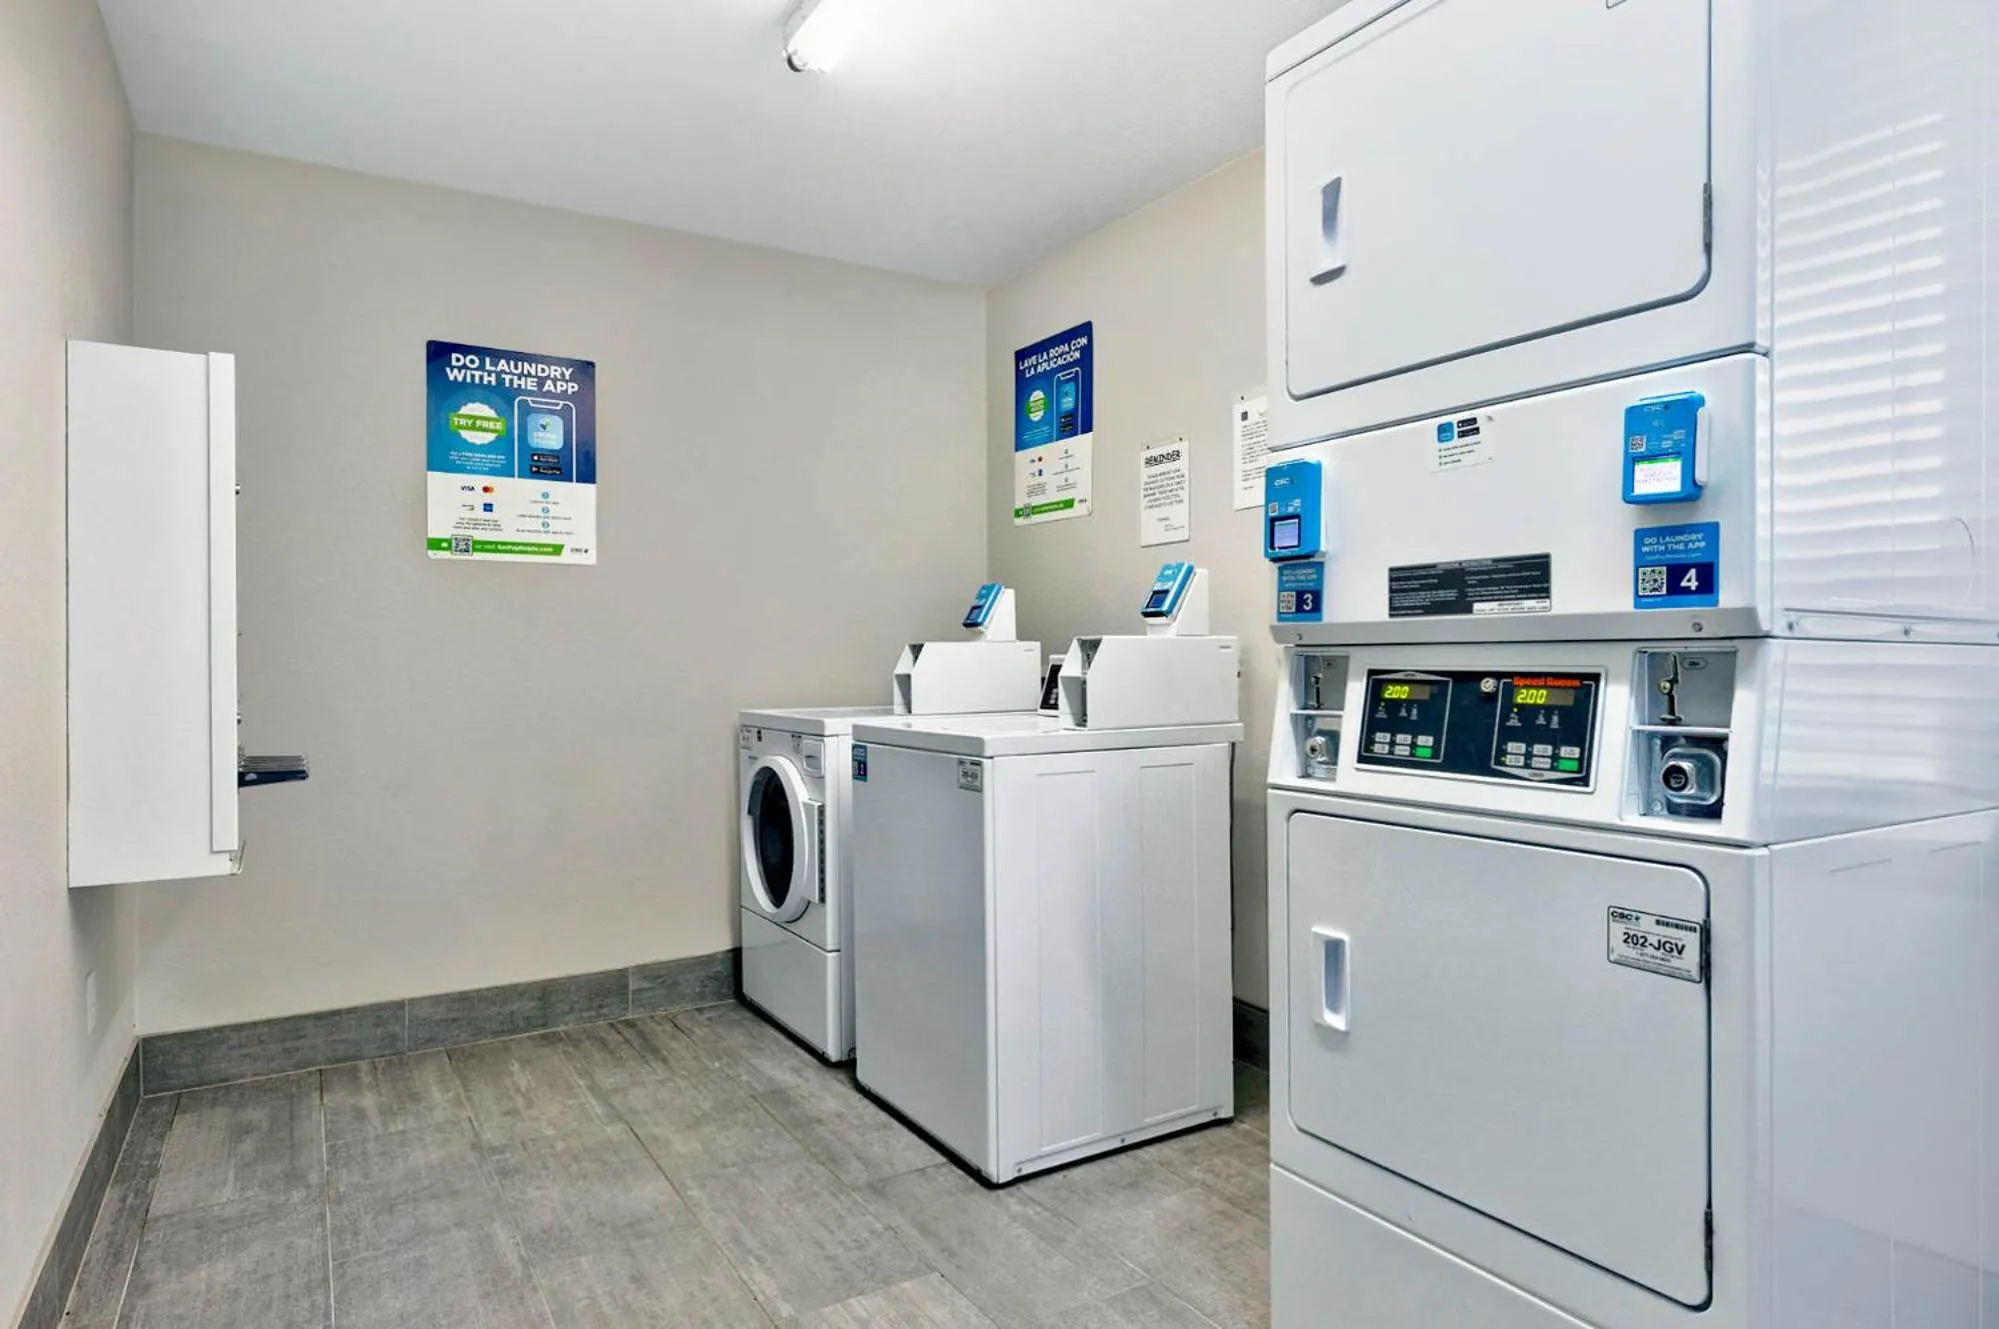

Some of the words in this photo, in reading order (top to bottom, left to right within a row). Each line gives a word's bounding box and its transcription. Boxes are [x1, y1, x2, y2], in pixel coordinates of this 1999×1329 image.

[1019, 354, 1037, 370] LAVE
[1038, 352, 1048, 363] LA
[1049, 343, 1070, 358] ROPA
[1071, 336, 1088, 349] CON
[451, 352, 480, 368] DO
[485, 356, 574, 380] LAUNDRY
[1025, 368, 1035, 378] LA
[1036, 350, 1081, 373] APLICACIÓN
[445, 367, 496, 386] WITH
[501, 374, 538, 391] THE
[542, 380, 579, 395] APP
[452, 417, 474, 427] TRY
[476, 420, 502, 430] FREE
[1659, 533, 1704, 542] LAUNDRY
[1642, 544, 1665, 552] WITH
[1680, 568, 1698, 591] 4
[1303, 593, 1312, 610] 3
[1513, 676, 1545, 687] Speed
[1384, 685, 1410, 698] 2.00
[1517, 690, 1547, 704] 2.00
[1610, 910, 1633, 921] CSC
[1622, 932, 1686, 956] 202-JGV
